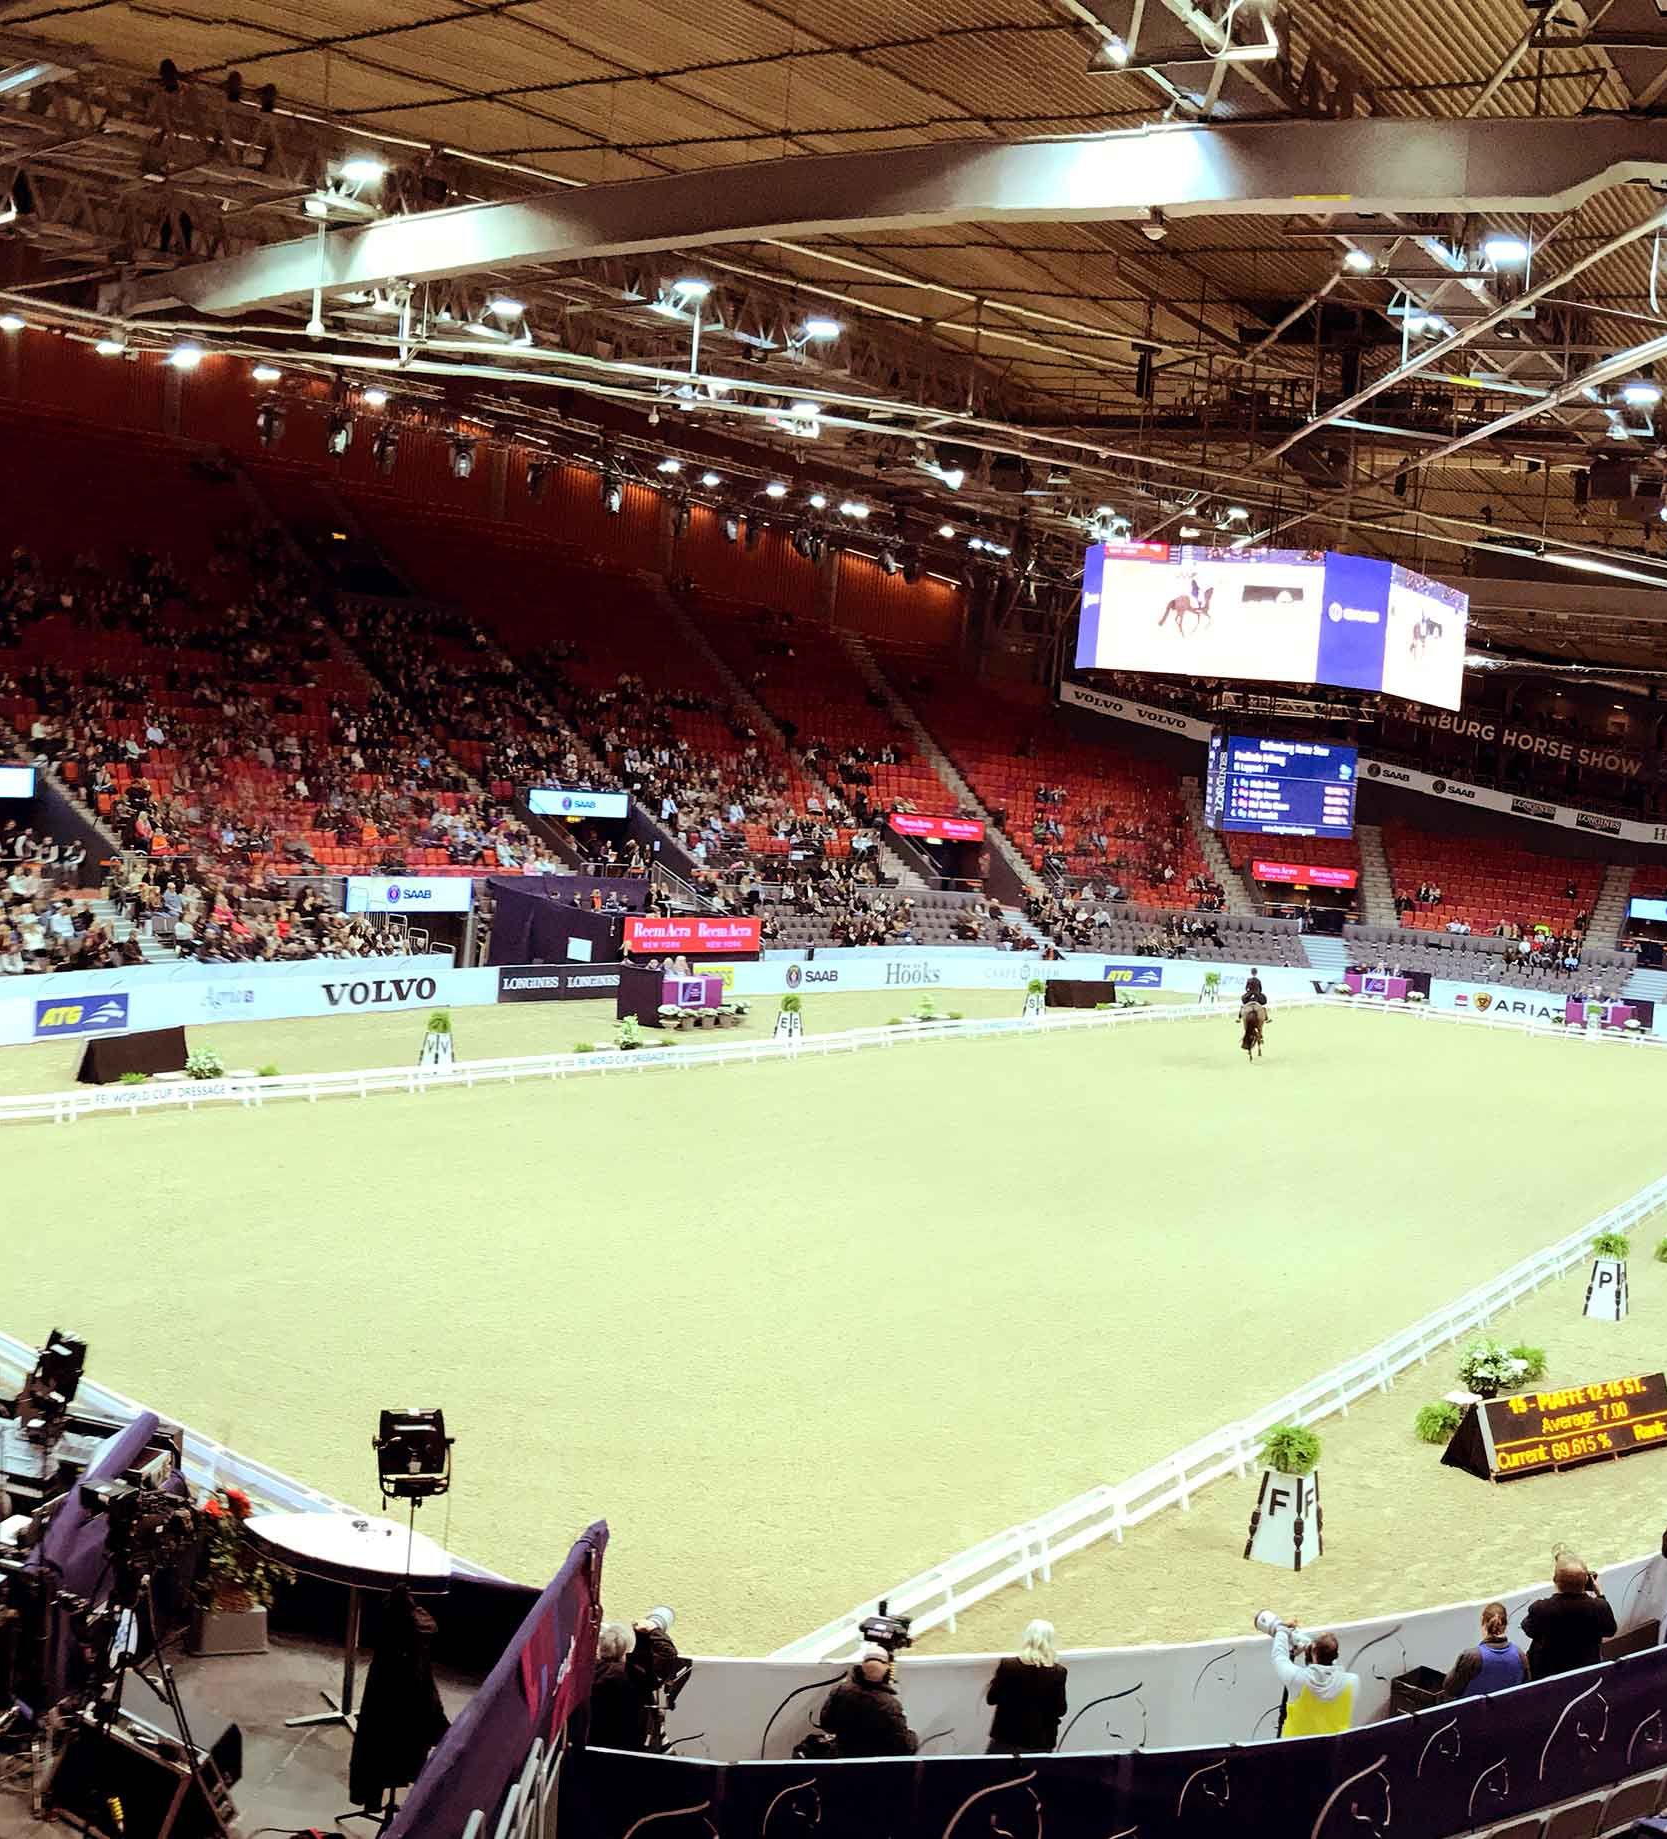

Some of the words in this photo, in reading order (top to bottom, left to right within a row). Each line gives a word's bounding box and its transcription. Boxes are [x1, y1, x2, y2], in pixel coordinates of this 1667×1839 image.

[1074, 691, 1123, 712] VOLVO
[1136, 708, 1187, 728] VOLVO
[1502, 729, 1574, 760] HORSE
[1578, 749, 1643, 777] SHOW
[1382, 769, 1410, 782] SAAB
[1447, 785, 1475, 798] SAAB
[1578, 813, 1622, 829] LONGINES
[403, 889, 432, 899] SAAB
[502, 976, 559, 990] LONGINES
[566, 974, 620, 989] LONGINES
[805, 969, 839, 983] SAAB
[886, 963, 941, 985] Hööks
[1106, 968, 1133, 983] ATG
[322, 977, 437, 1006] VOLVO
[37, 1005, 83, 1027] ATG
[114, 1090, 150, 1102] WORLD
[154, 1088, 174, 1100] CUP
[178, 1084, 226, 1097] DRESSAGE
[1599, 1271, 1612, 1288] P
[1542, 1408, 1600, 1434] Average:
[1599, 1401, 1629, 1420] 7.00
[1552, 1434, 1597, 1460] 69.615
[1597, 1431, 1613, 1449] %
[1268, 1487, 1290, 1516] F
[1305, 1487, 1314, 1518] F
